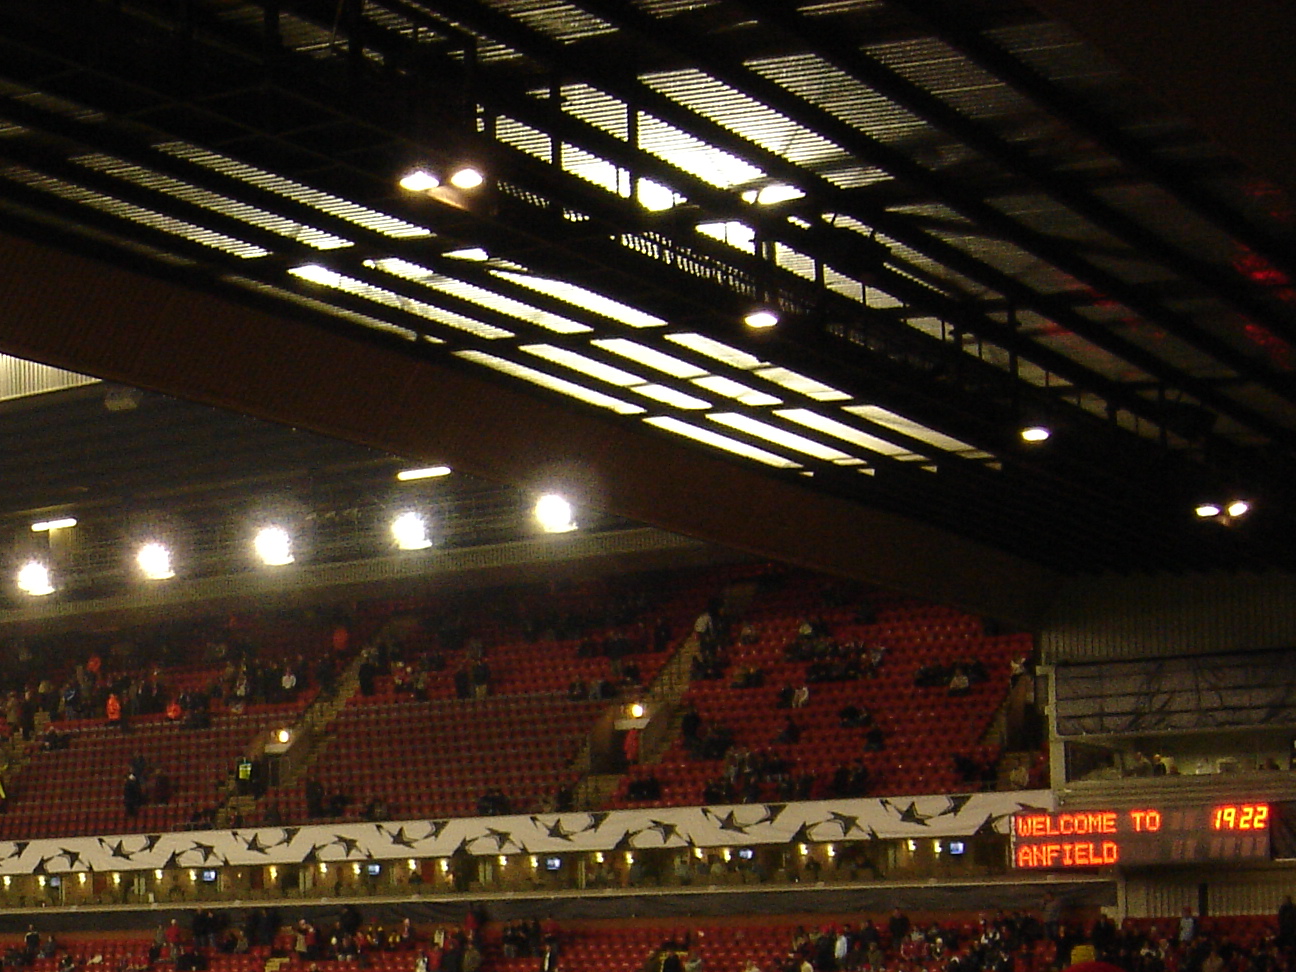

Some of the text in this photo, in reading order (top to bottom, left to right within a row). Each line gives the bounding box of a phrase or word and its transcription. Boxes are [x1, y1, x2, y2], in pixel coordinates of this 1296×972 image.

[1017, 810, 1161, 836] WELCOME TO
[1018, 842, 1118, 867] ANFIELD
